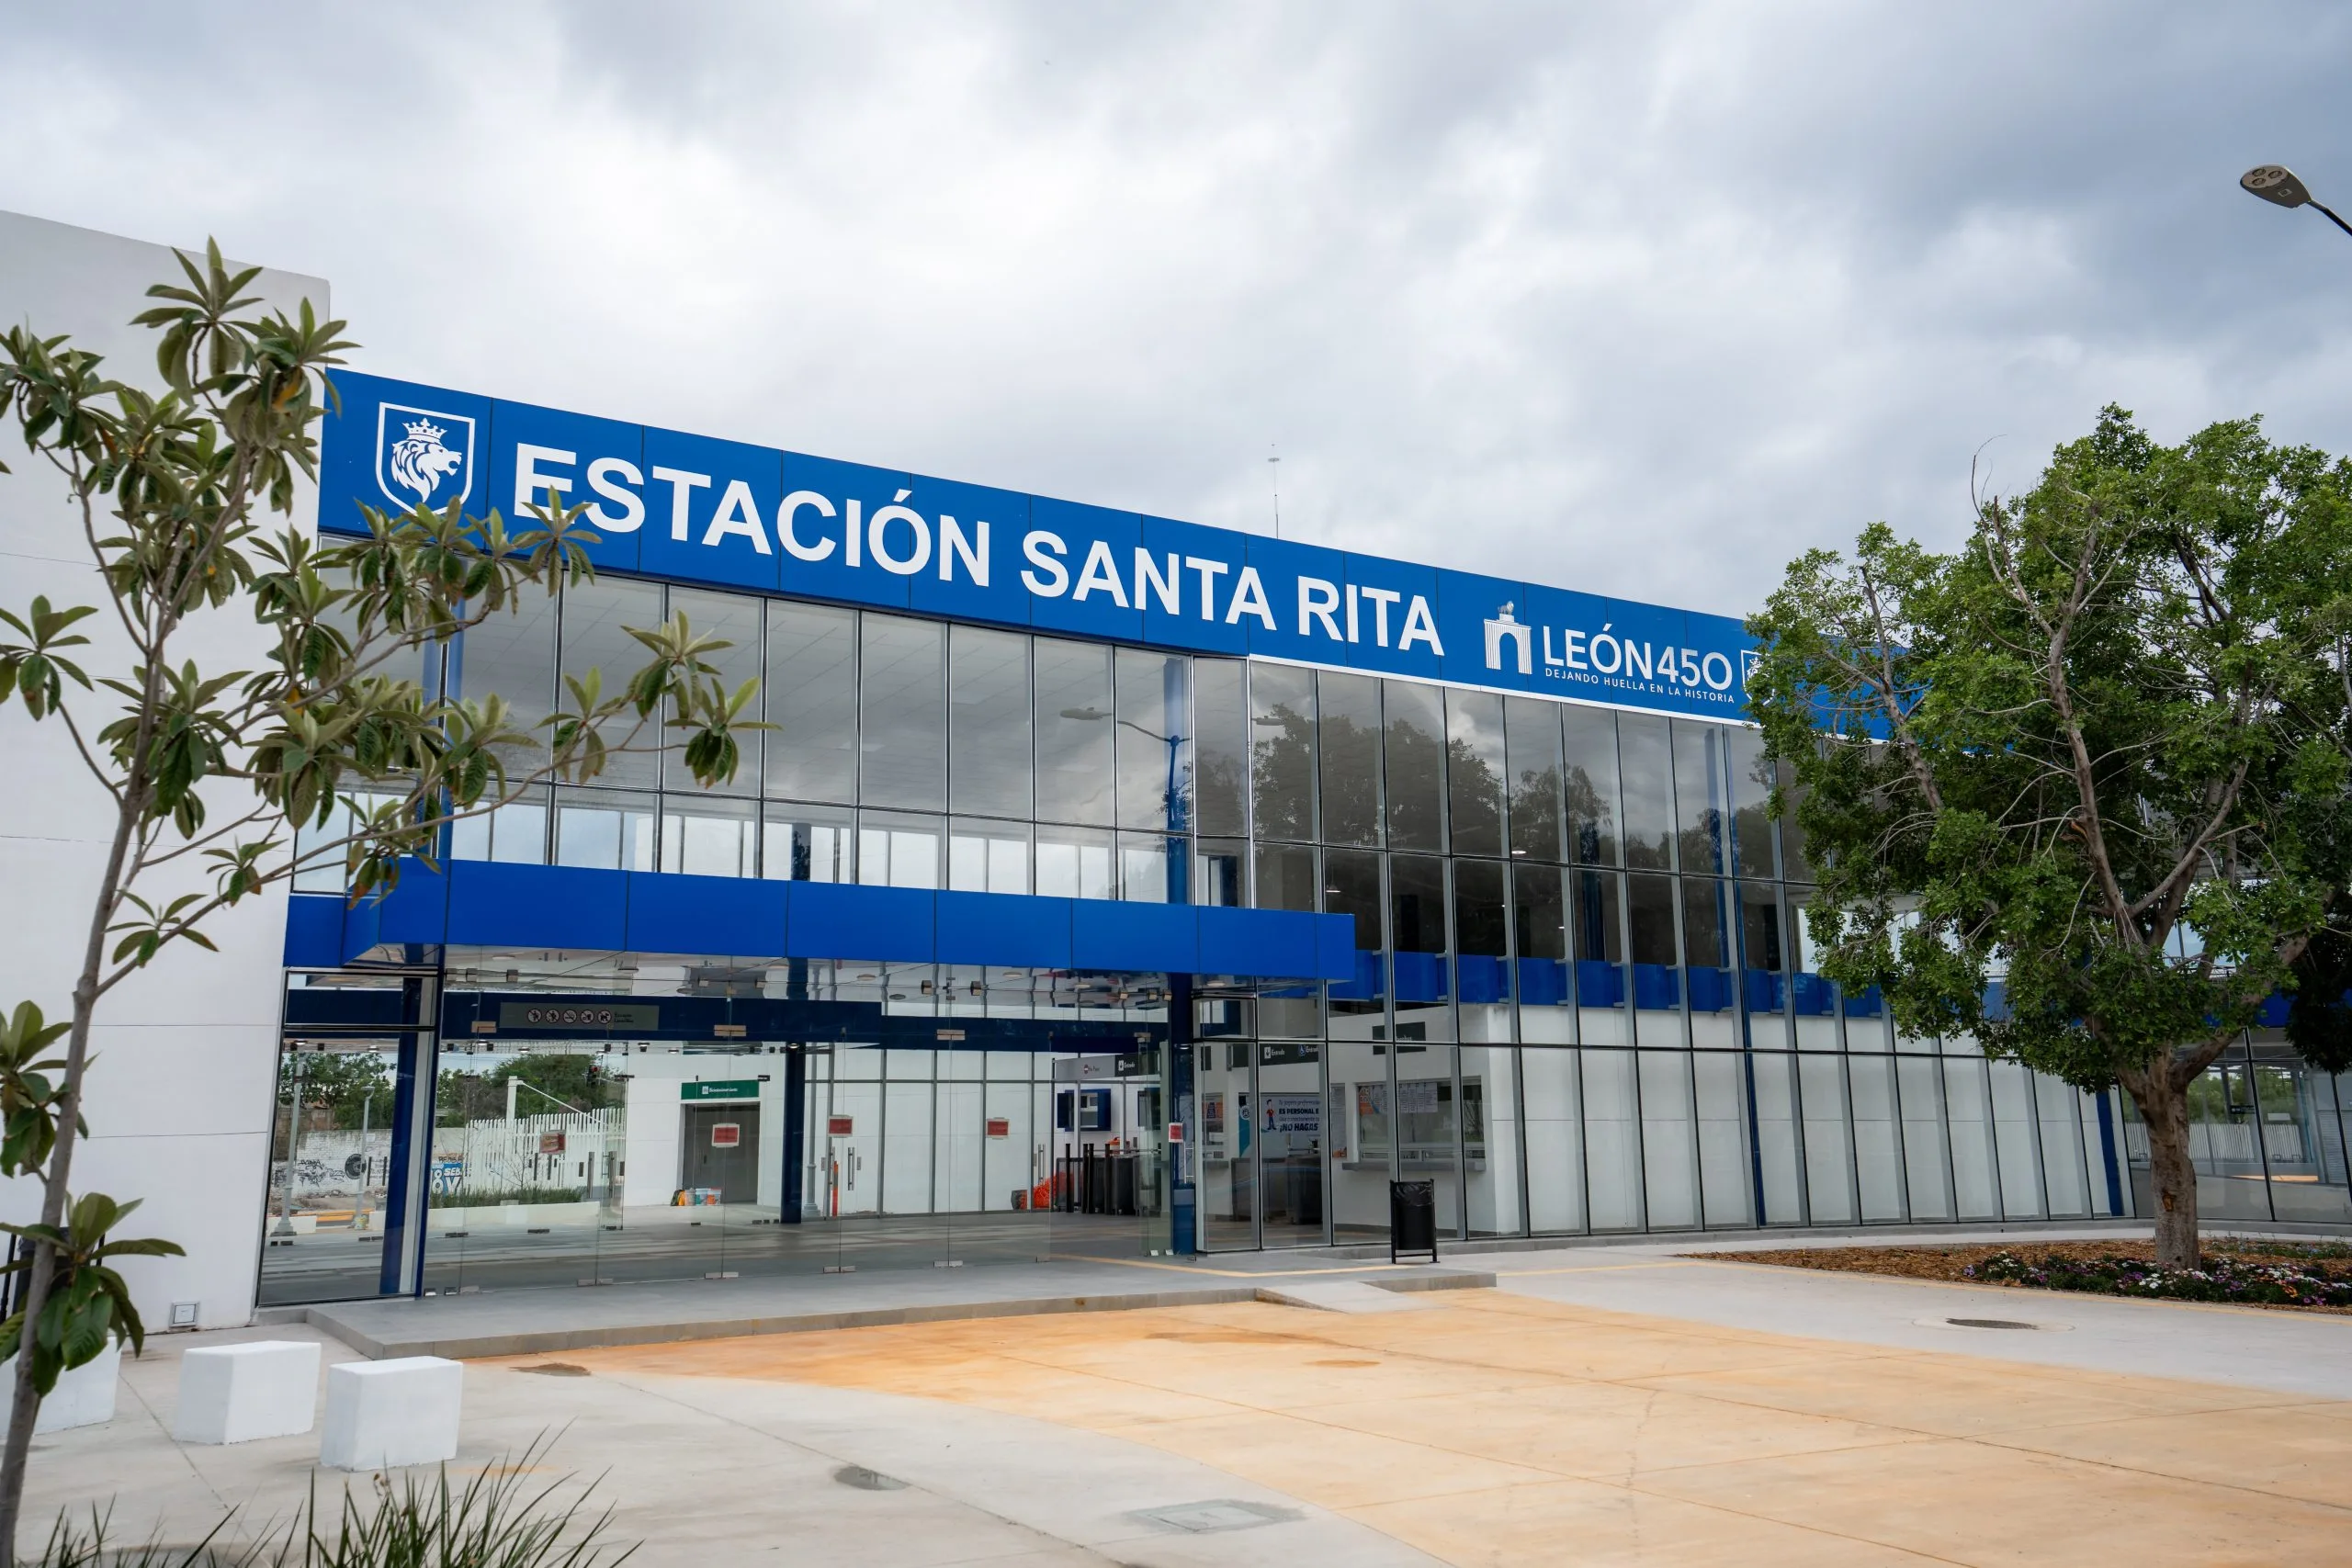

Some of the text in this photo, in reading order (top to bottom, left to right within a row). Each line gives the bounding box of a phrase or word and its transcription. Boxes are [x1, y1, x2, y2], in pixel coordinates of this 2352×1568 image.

[514, 442, 1445, 657] ESTACIÓN SANTA RITA
[1545, 667, 1735, 704] DEJANDO HUELLA EN LA HISTORIA
